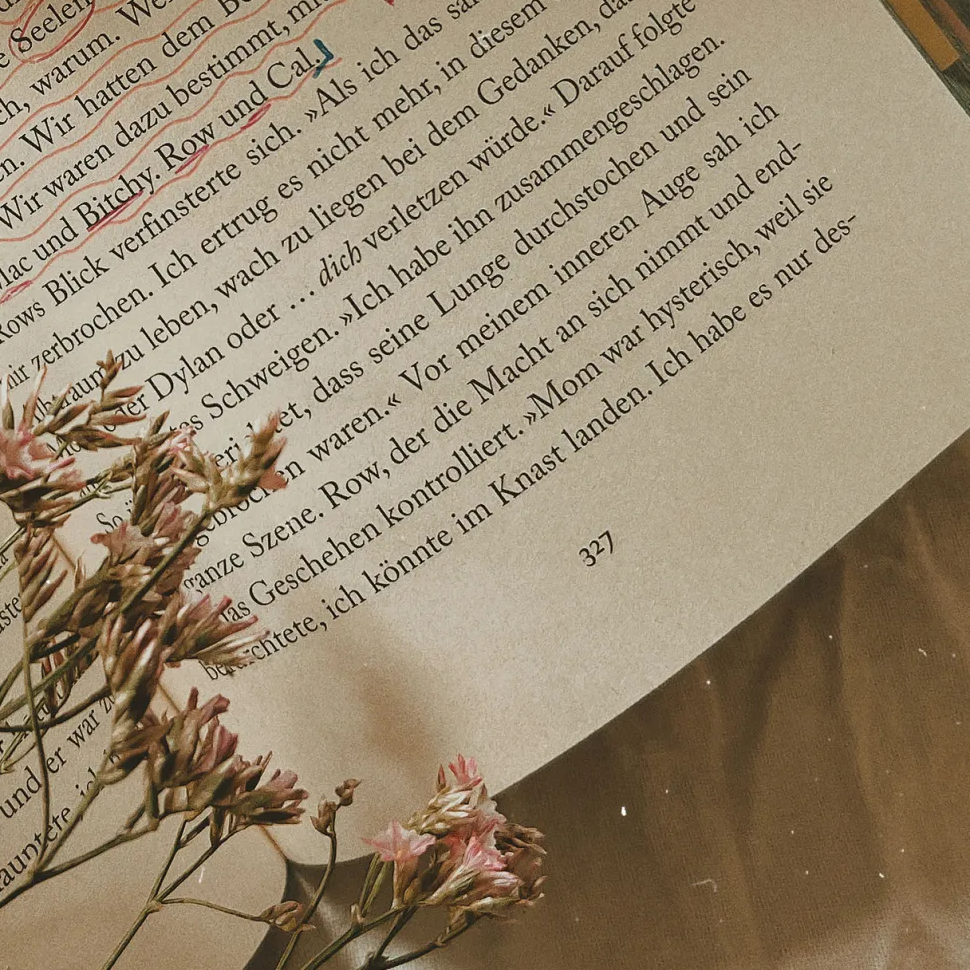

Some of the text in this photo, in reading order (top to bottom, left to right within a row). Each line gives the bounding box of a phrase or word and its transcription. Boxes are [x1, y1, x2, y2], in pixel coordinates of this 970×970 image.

[30, 288, 154, 372] zerbrochen.
[146, 248, 198, 289] Ich
[200, 195, 279, 255] ertrug
[277, 174, 304, 200] es
[306, 125, 371, 180] nicht
[371, 78, 442, 132] mehr,
[434, 56, 468, 82] in
[41, 144, 116, 198] waren
[114, 101, 174, 148] dazu
[164, 20, 291, 108] bestimmt,
[338, 36, 726, 327] »Ich habe ihn zusammengeschlagen.
[320, 214, 857, 620] ich könnte im Knast landen. Ich habe es nur des-
[578, 530, 614, 568] 327
